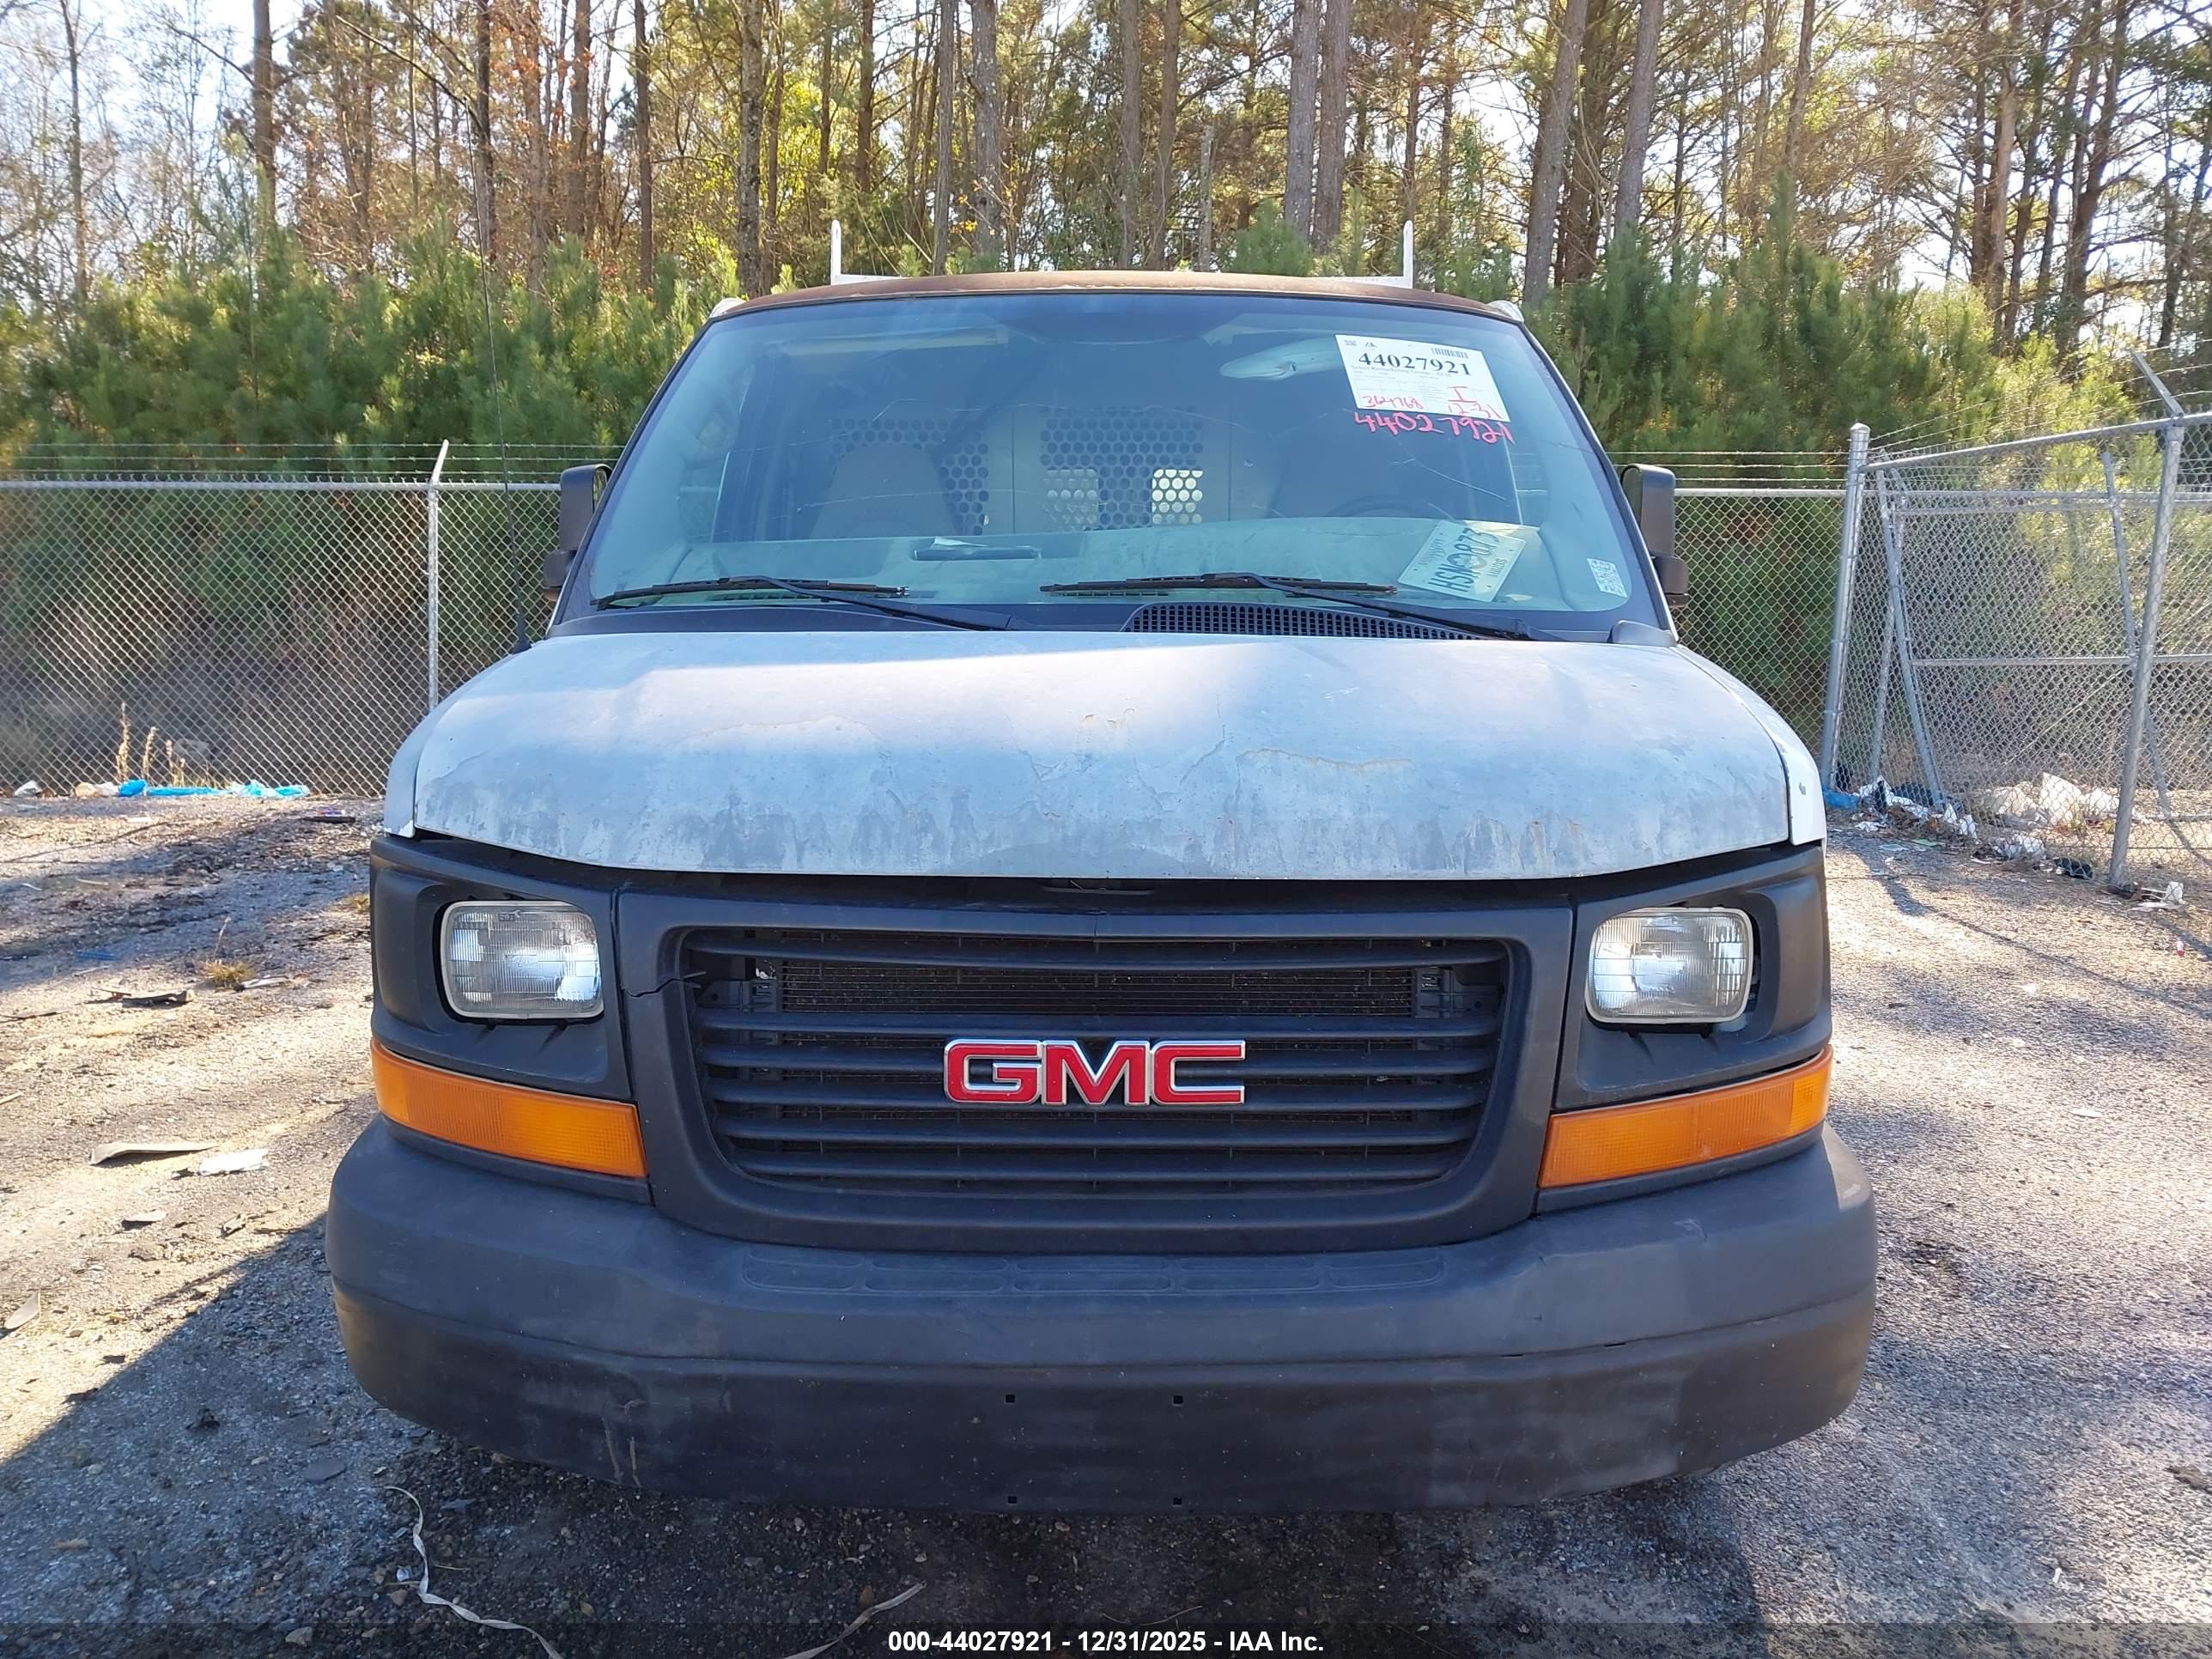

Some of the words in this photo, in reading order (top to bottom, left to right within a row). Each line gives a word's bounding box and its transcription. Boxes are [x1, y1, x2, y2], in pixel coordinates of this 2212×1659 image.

[1358, 352, 1471, 375] 44027921
[1354, 411, 1516, 445] 44027921
[945, 1038, 1245, 1105] GMC
